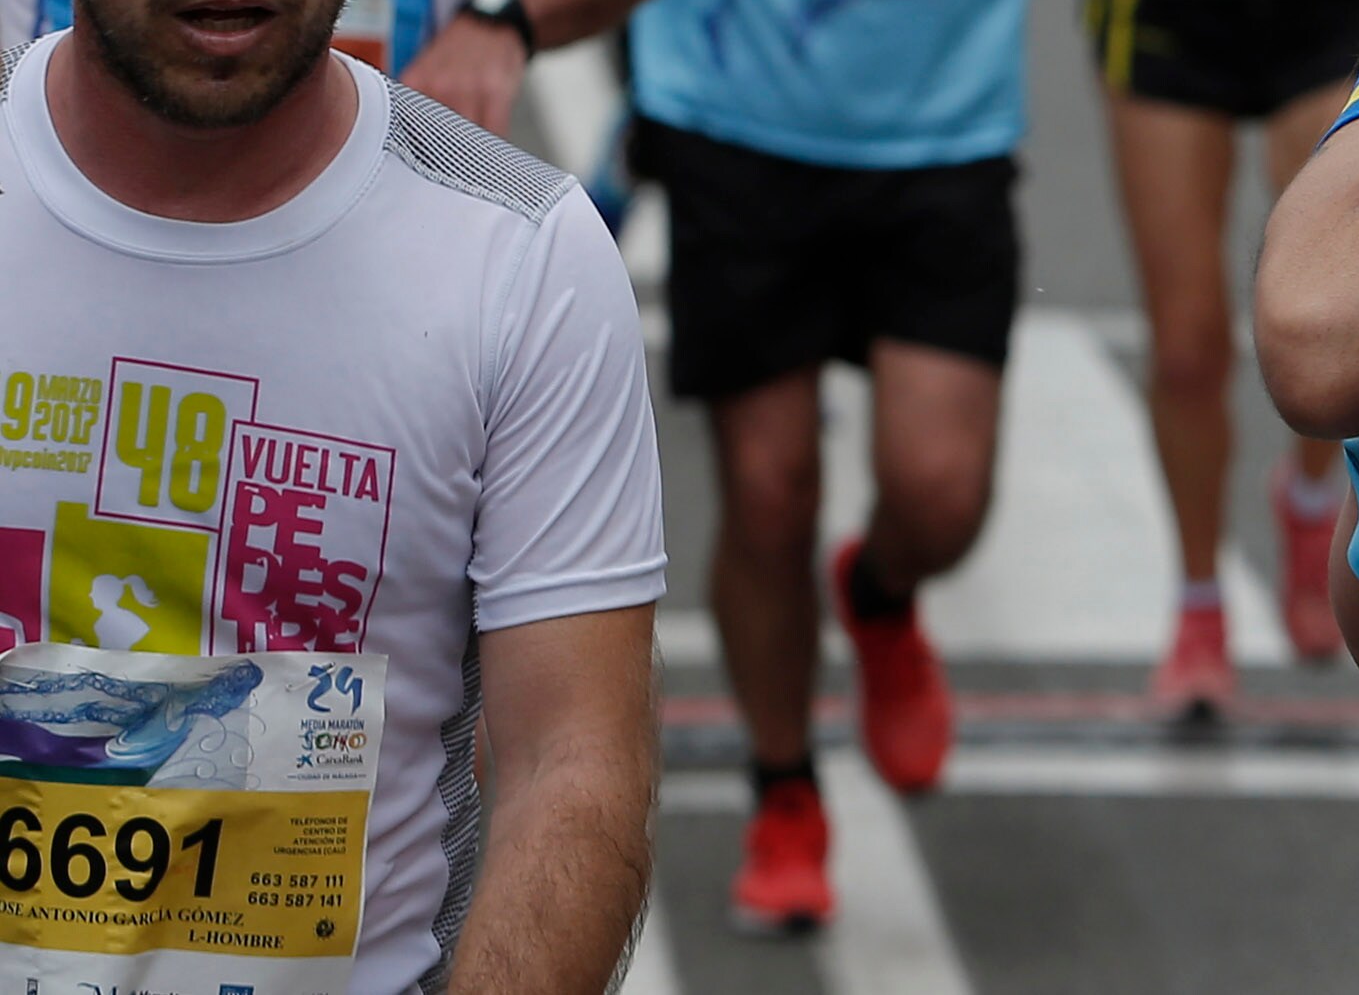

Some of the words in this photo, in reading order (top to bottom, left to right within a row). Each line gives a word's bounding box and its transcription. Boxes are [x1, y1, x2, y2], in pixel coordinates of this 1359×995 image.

[32, 402, 99, 445] 2017
[116, 380, 226, 513] 48
[241, 434, 379, 503] VUELTA
[233, 480, 327, 563] PE
[301, 718, 326, 730] MEDIA
[328, 717, 365, 730] MARATÓN
[316, 753, 363, 765] CaixaBank
[290, 816, 336, 826] TELÉFONOS
[338, 816, 348, 825] DE
[303, 827, 335, 836] CENTRO
[337, 827, 347, 835] DE
[292, 836, 334, 846] ATENCIÓN
[336, 837, 346, 845] DE
[0, 806, 223, 902] 6691
[273, 846, 322, 855] URGENCIAS
[251, 872, 282, 888] 663
[289, 874, 318, 888] 587
[325, 875, 345, 889] 111
[248, 891, 279, 906] 663
[285, 893, 314, 907] 587
[320, 894, 342, 907] 141
[28, 902, 108, 923] ANTONIO
[113, 905, 173, 926] GARCÍA
[178, 906, 244, 927] GÓMEZ
[188, 928, 285, 950] L-HOMBRE
